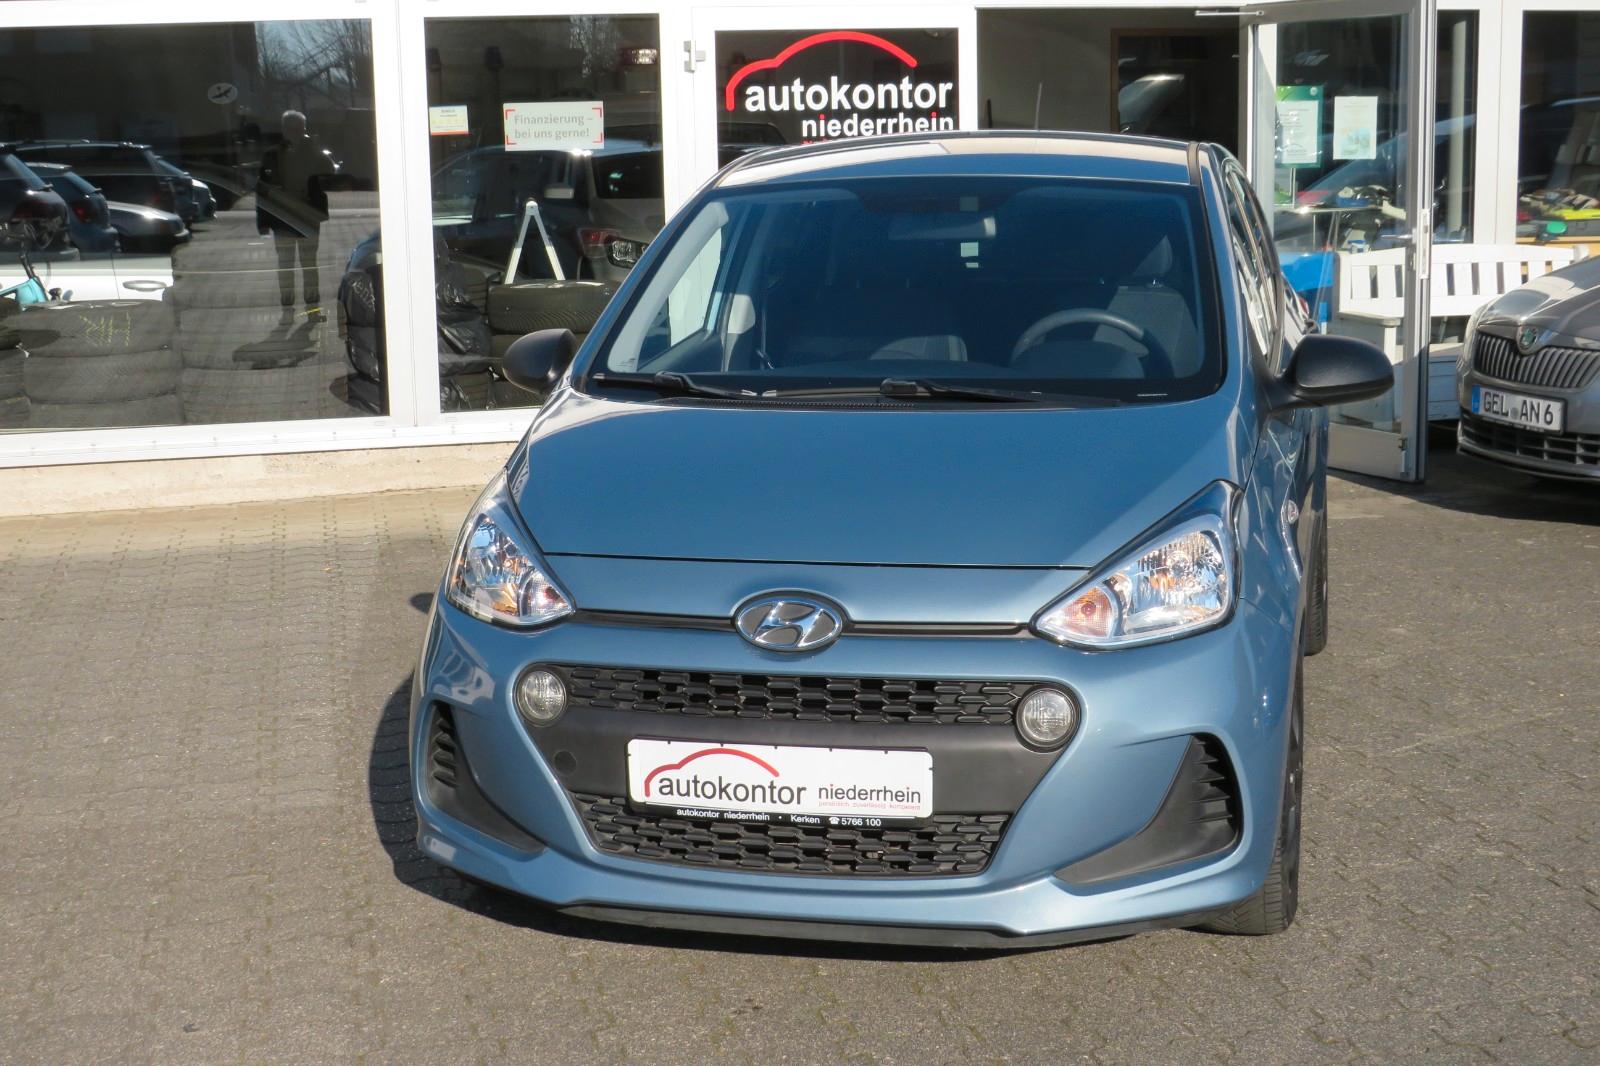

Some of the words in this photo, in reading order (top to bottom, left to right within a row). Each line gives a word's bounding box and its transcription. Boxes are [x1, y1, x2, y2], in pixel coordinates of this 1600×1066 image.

[744, 76, 954, 111] autokontor
[514, 114, 585, 126] Finanzierung
[802, 111, 954, 137] niederrhein
[514, 128, 532, 139] bei
[534, 130, 553, 138] uns
[555, 129, 590, 140] gerne!
[1483, 391, 1509, 417] GEL
[1520, 399, 1540, 424] AN
[1544, 404, 1554, 425] 6
[658, 774, 807, 805] autokontor
[818, 784, 921, 803] niederrhein
[676, 808, 720, 819] autokontor
[723, 810, 770, 821] niederrhein
[790, 814, 820, 824] Kerken
[841, 817, 863, 826] 5766
[865, 818, 882, 827] 100
